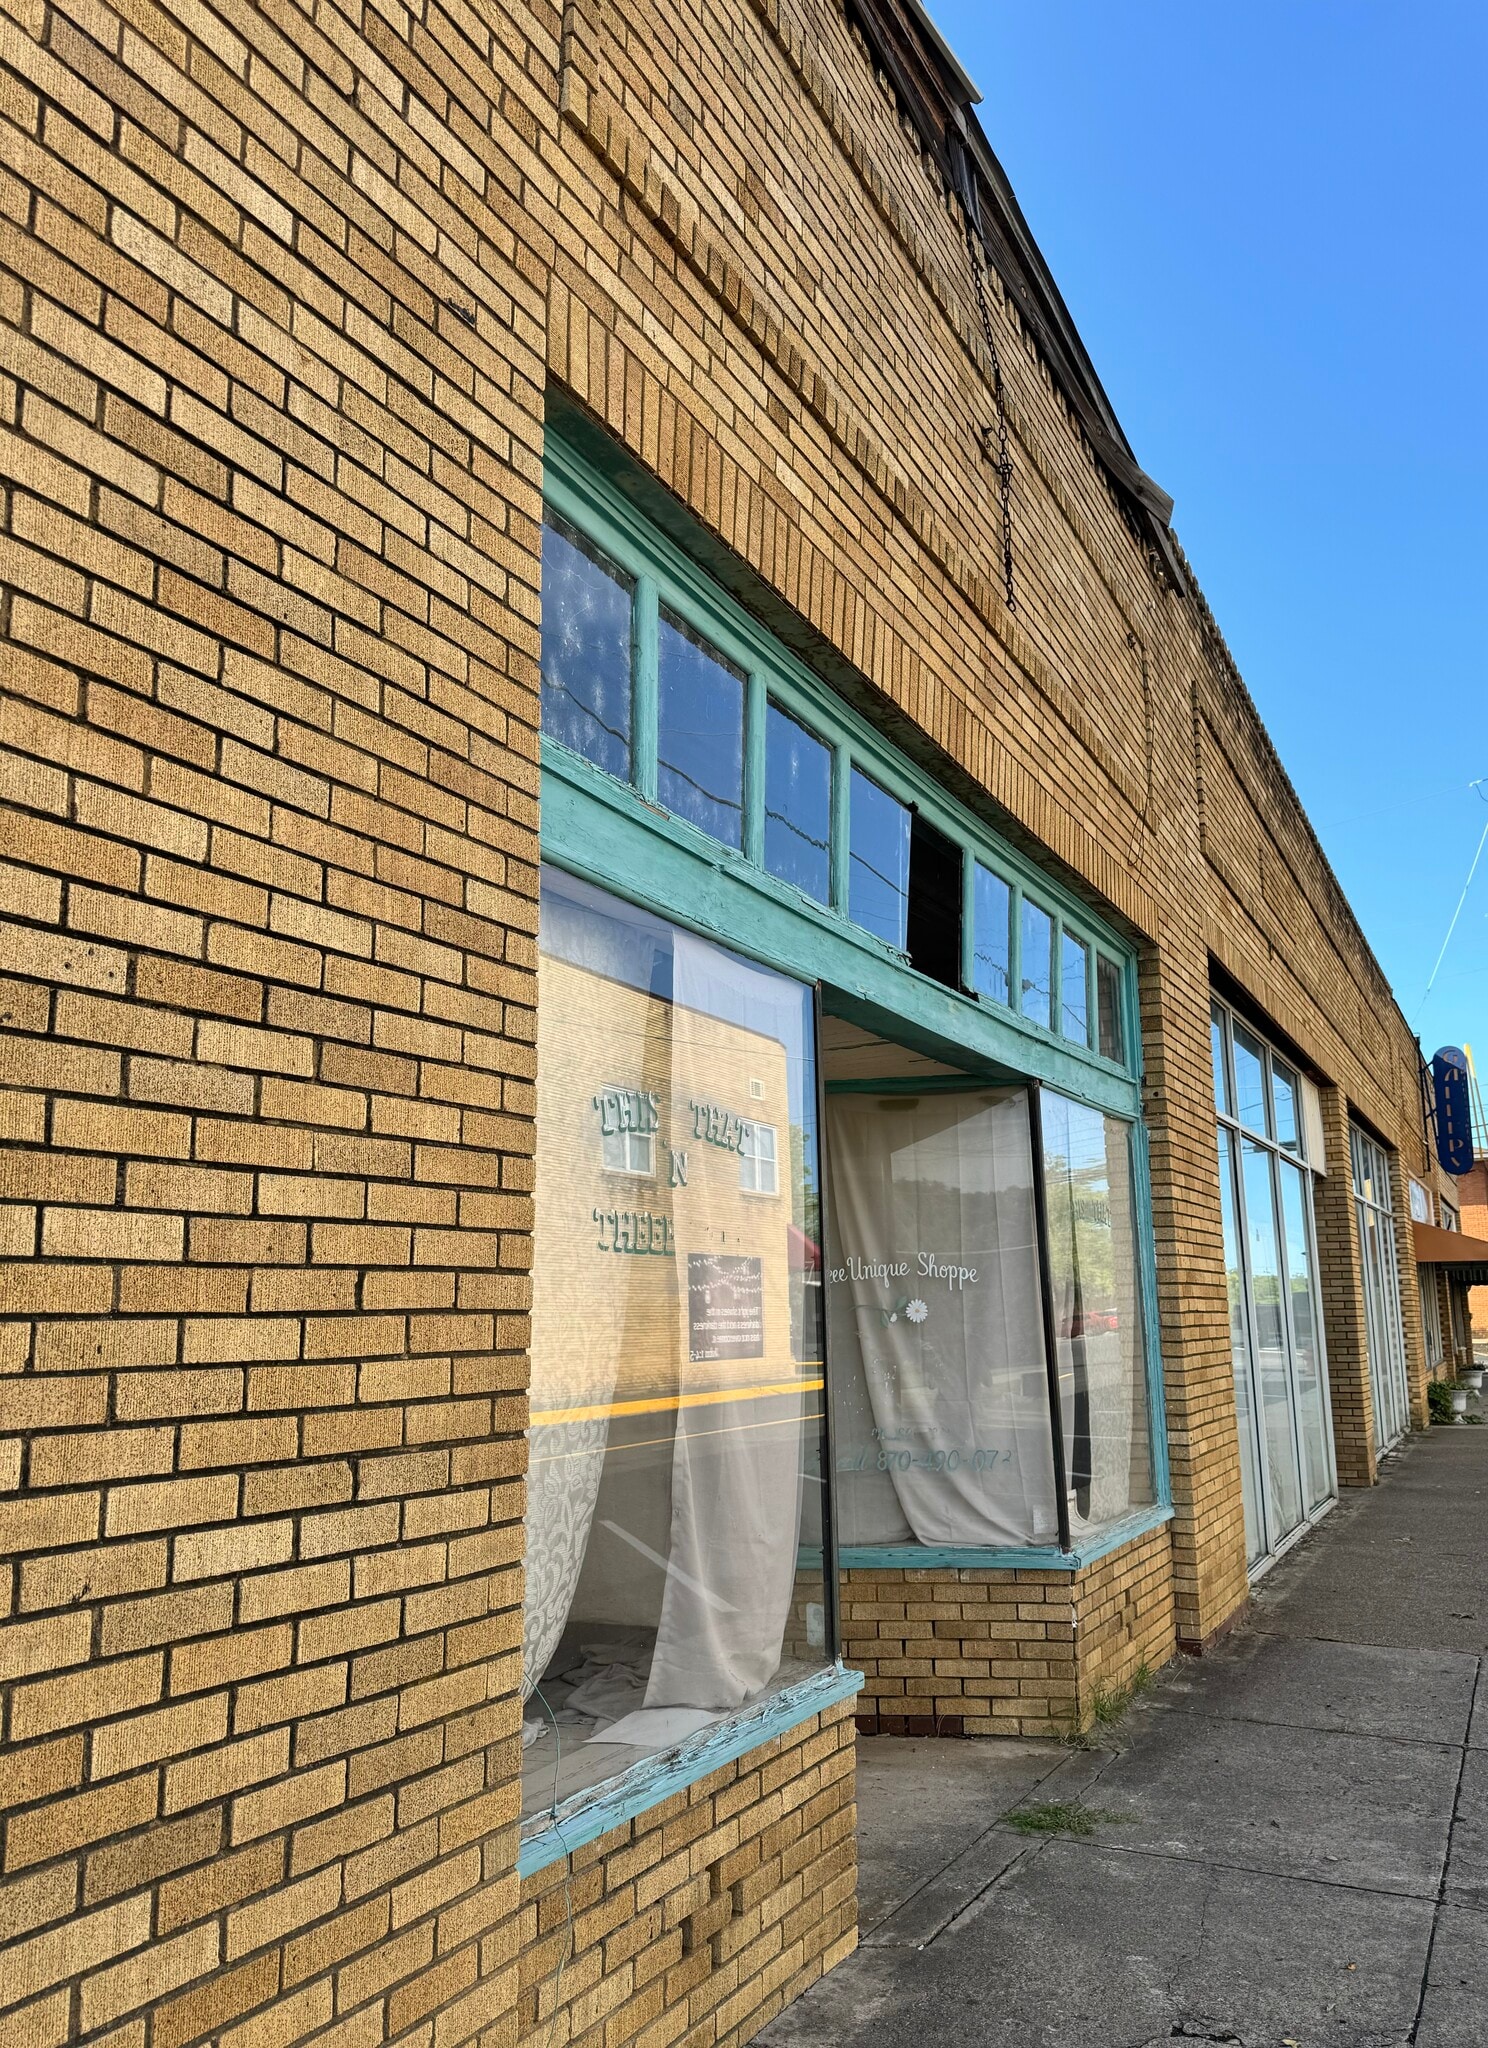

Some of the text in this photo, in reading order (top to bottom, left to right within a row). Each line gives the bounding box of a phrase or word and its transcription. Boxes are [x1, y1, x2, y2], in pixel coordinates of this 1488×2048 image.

[592, 1090, 660, 1136] THIS
[689, 1099, 749, 1156] THAT
[917, 1251, 979, 1290] Shoppe
